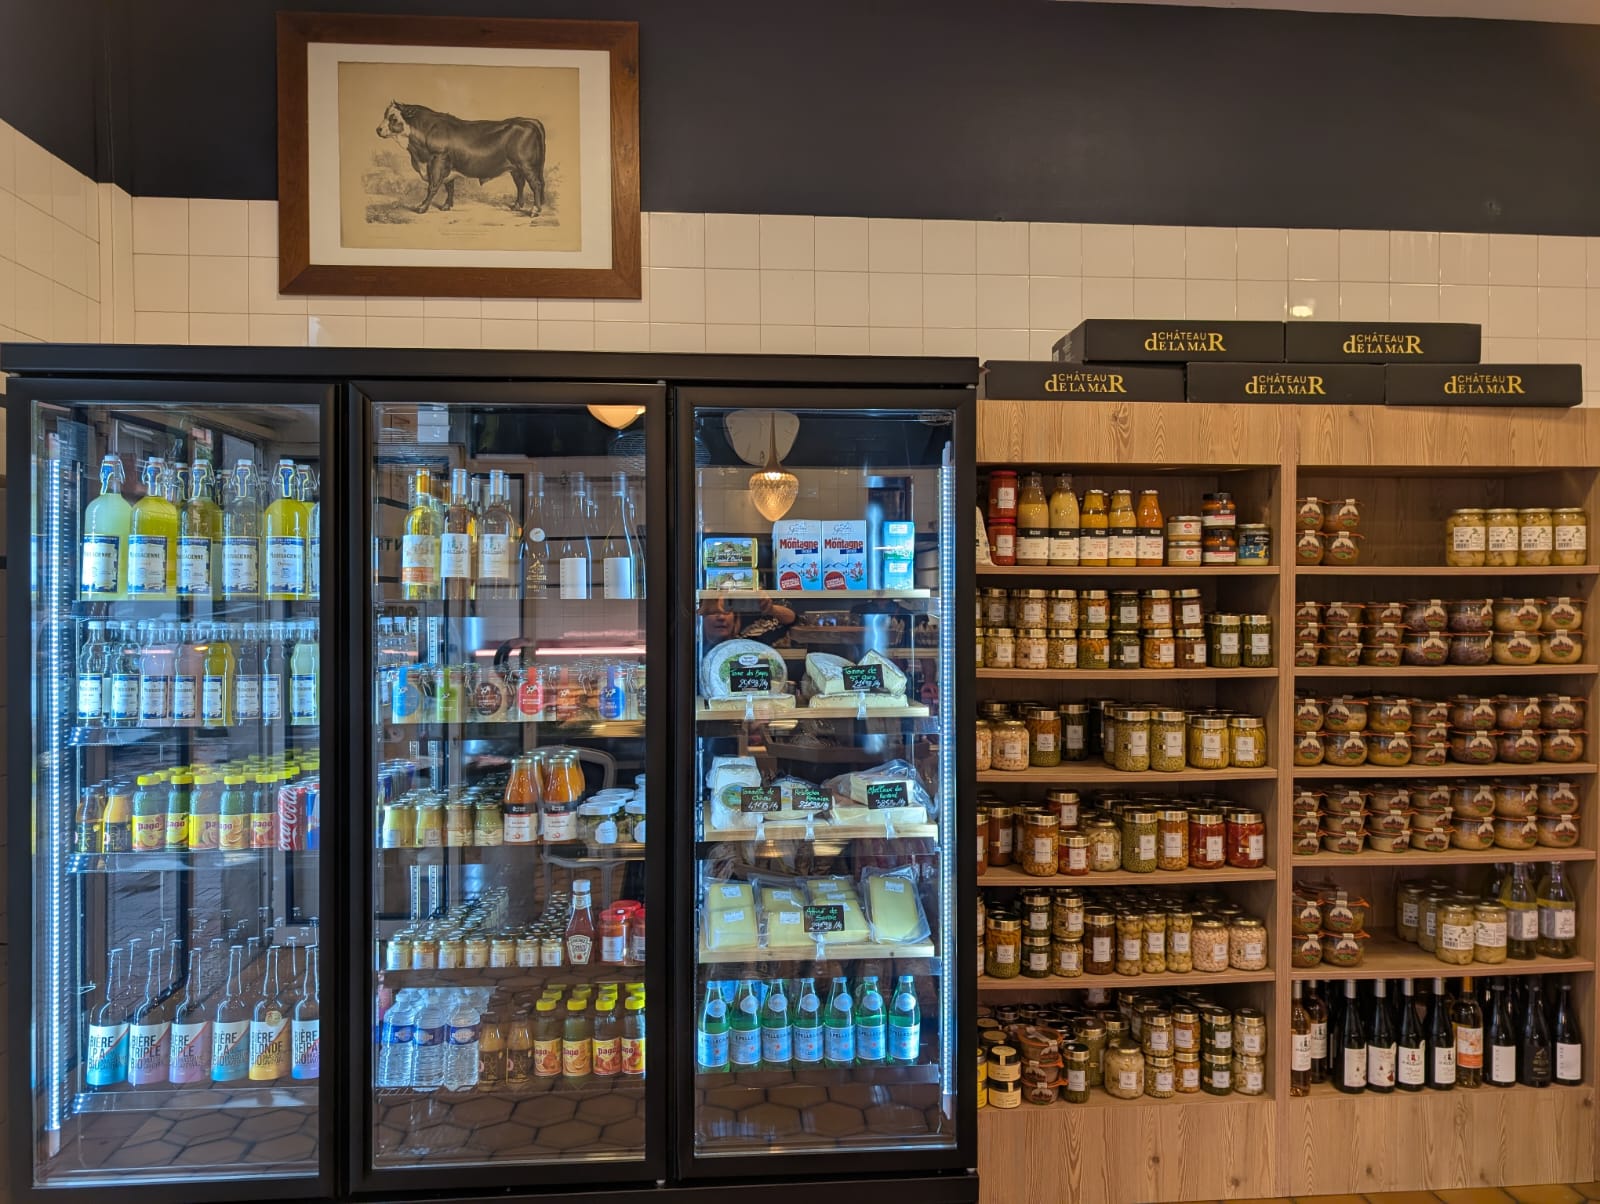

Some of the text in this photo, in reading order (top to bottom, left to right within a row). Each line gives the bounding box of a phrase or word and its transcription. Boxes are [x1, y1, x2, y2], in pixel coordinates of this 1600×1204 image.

[1158, 329, 1208, 340] CHÂTEAU
[1356, 332, 1406, 343] CHÂTEAU
[1058, 370, 1108, 382] CHÂTEAU
[1258, 372, 1308, 384] CHÂTEAU
[1458, 371, 1506, 383] CHÂTEAU
[780, 539, 818, 550] Montagne
[824, 539, 864, 550] Montagne
[138, 822, 160, 832] pago
